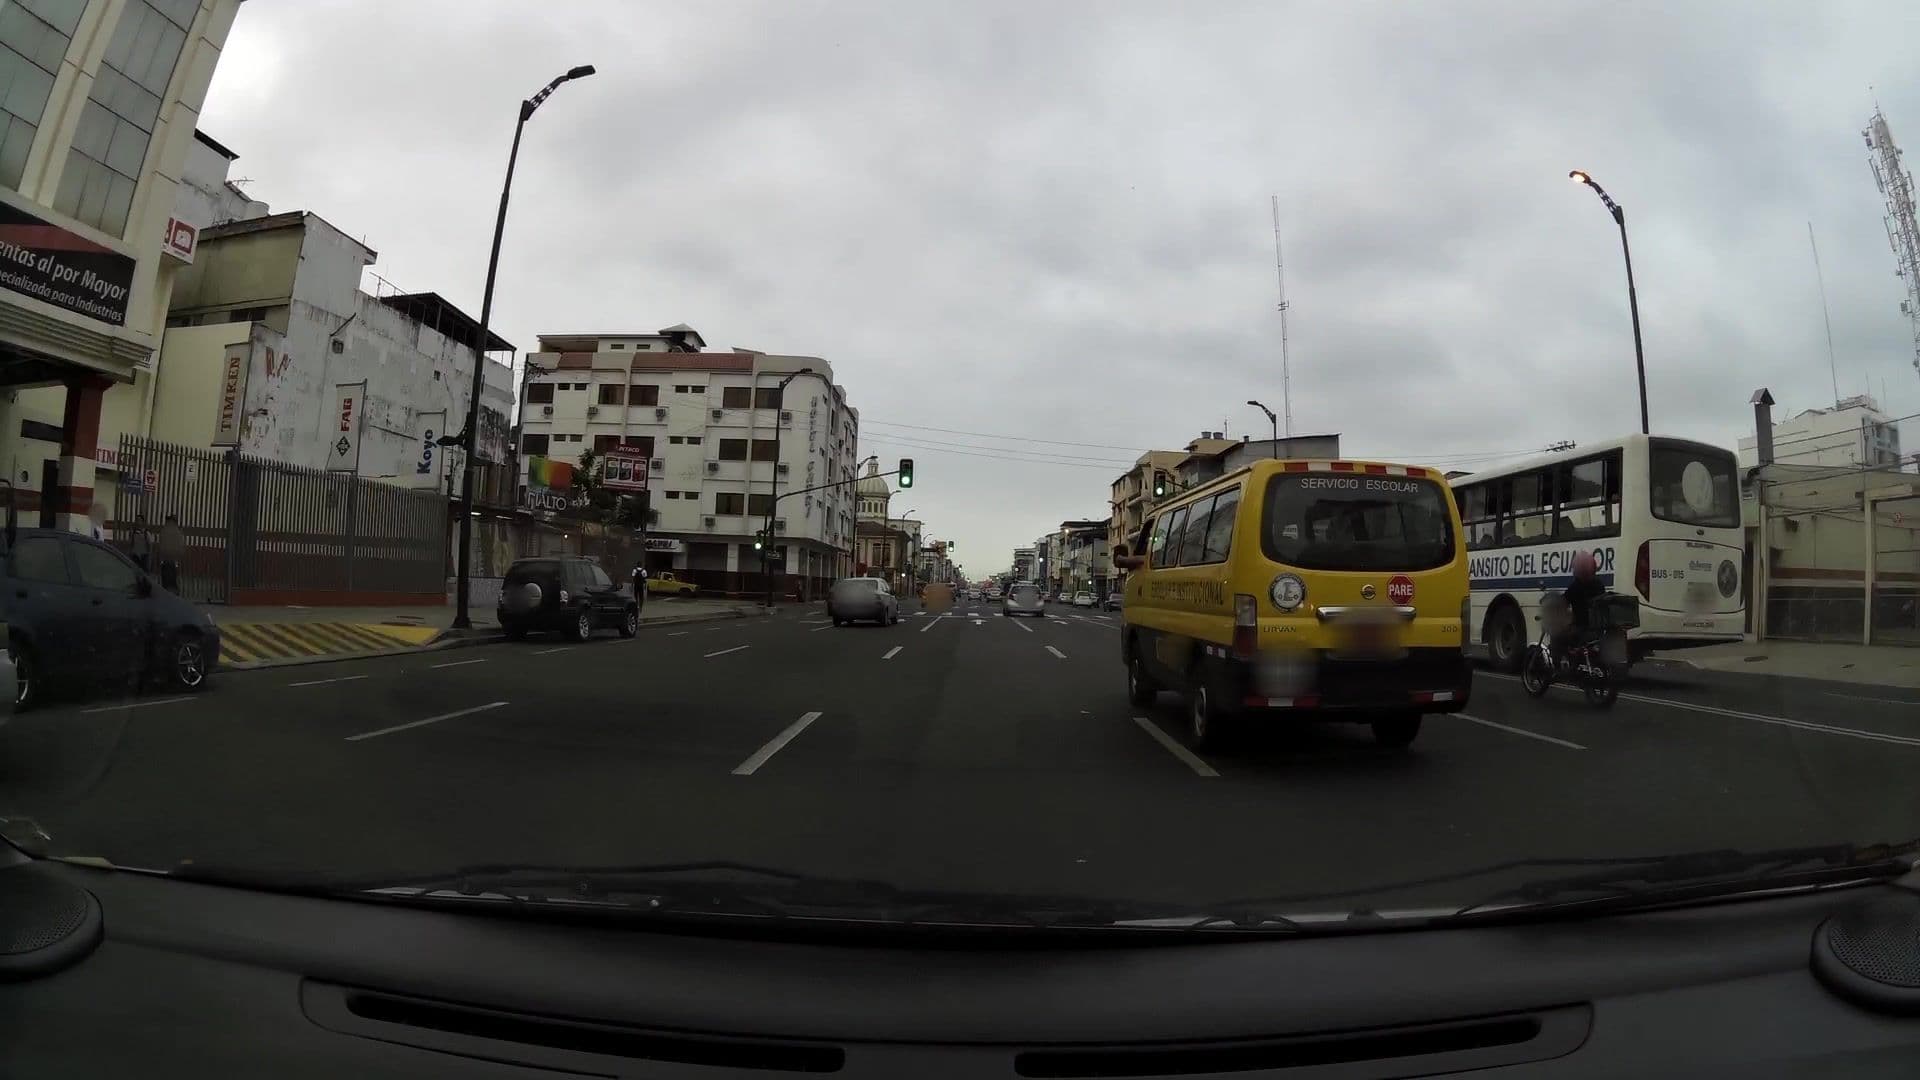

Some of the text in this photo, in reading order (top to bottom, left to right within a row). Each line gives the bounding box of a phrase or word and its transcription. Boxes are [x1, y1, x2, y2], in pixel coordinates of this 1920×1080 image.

[0, 270, 123, 322] ecializada para Industrias
[37, 255, 55, 274] al
[52, 263, 81, 283] por
[80, 269, 128, 300] Mayor
[220, 357, 241, 433] TIMKEN
[416, 429, 437, 474] Koyo
[1300, 478, 1419, 493] SERVICIO ESCOLAR
[1514, 553, 1537, 576] DEL
[1541, 546, 1615, 575] ECUAOR
[1651, 569, 1668, 579] BUS
[1388, 583, 1413, 596] PARE
